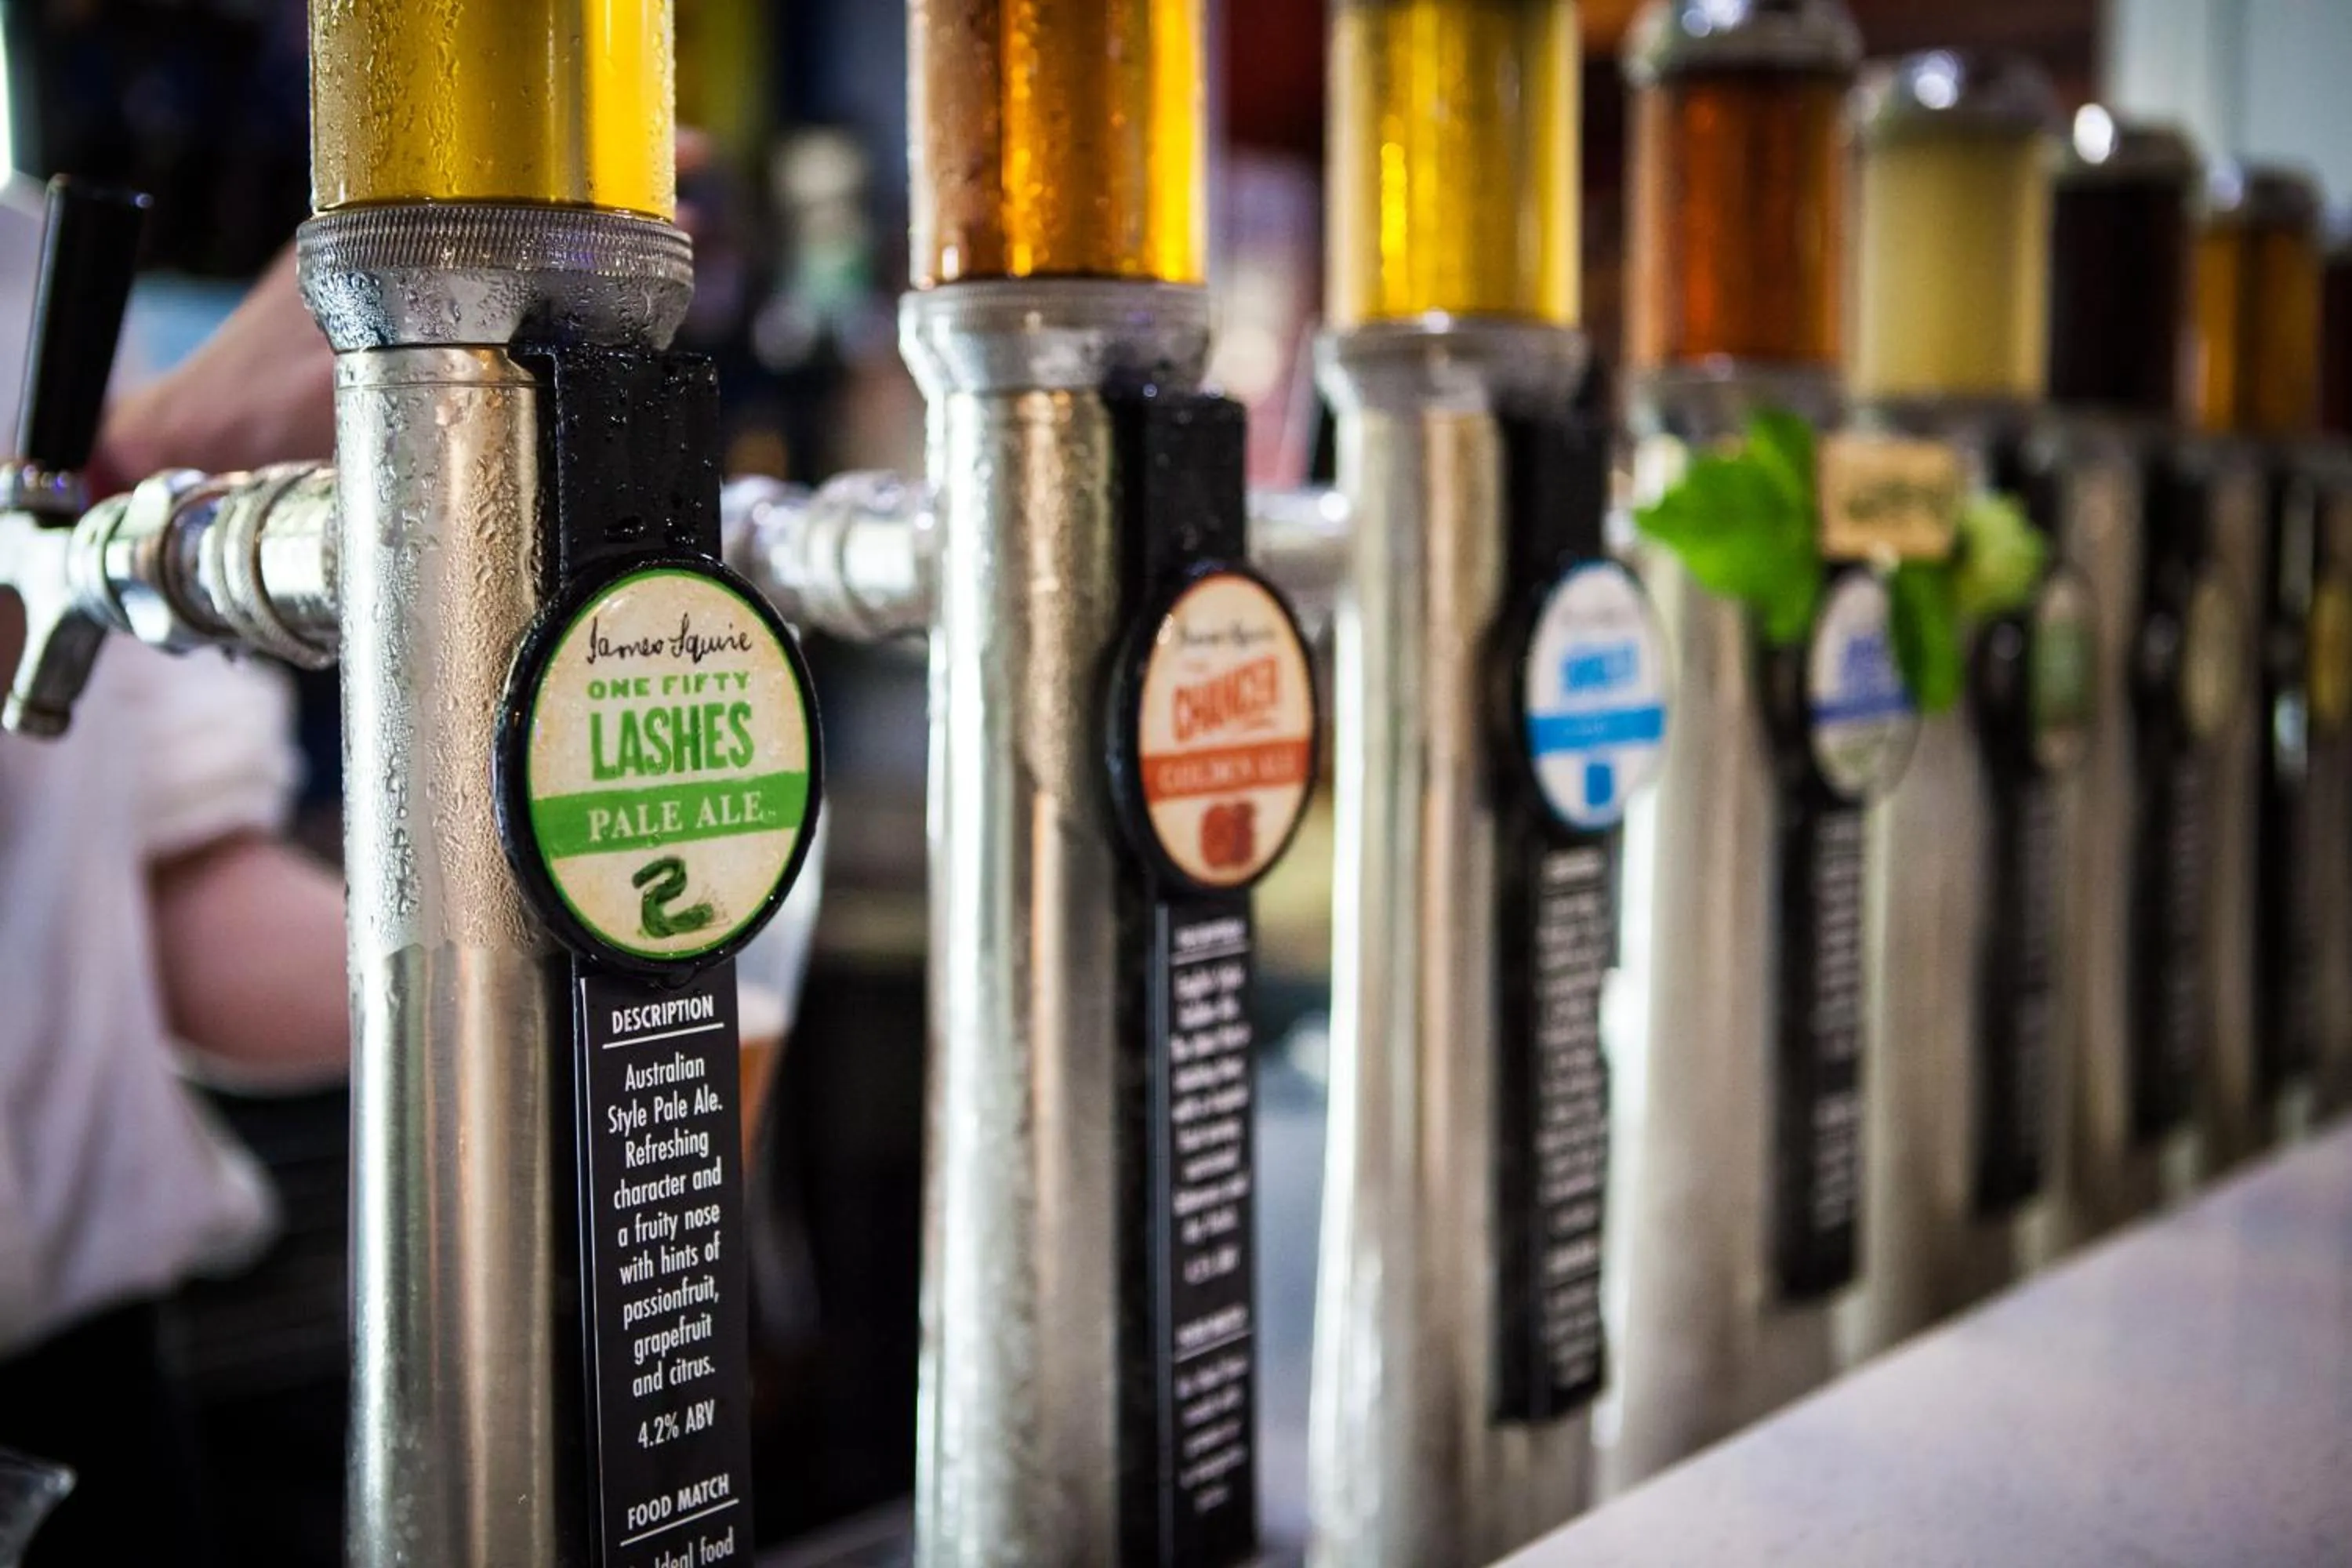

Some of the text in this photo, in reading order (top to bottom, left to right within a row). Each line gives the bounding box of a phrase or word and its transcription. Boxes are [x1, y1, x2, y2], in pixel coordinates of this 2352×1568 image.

[586, 612, 754, 666] James Squire
[586, 670, 750, 700] ONE FIFTY
[590, 701, 755, 781] LASHES
[587, 790, 764, 843] PALE ALE
[611, 994, 714, 1036] DESCRIPTION
[624, 1051, 706, 1092] Australian
[607, 1083, 724, 1137] Style Pale Ale.
[625, 1127, 709, 1169] Refreshing
[613, 1155, 722, 1210] character and
[617, 1203, 720, 1248] a fruity nose
[619, 1229, 721, 1287] with hints of
[622, 1275, 720, 1330] passionfruit,
[633, 1313, 712, 1367] grapefruit
[632, 1355, 716, 1398] and citrus.
[637, 1399, 715, 1450] 4.2% ABV
[627, 1473, 730, 1530] FOOD MATCH
[700, 1526, 735, 1566] food
